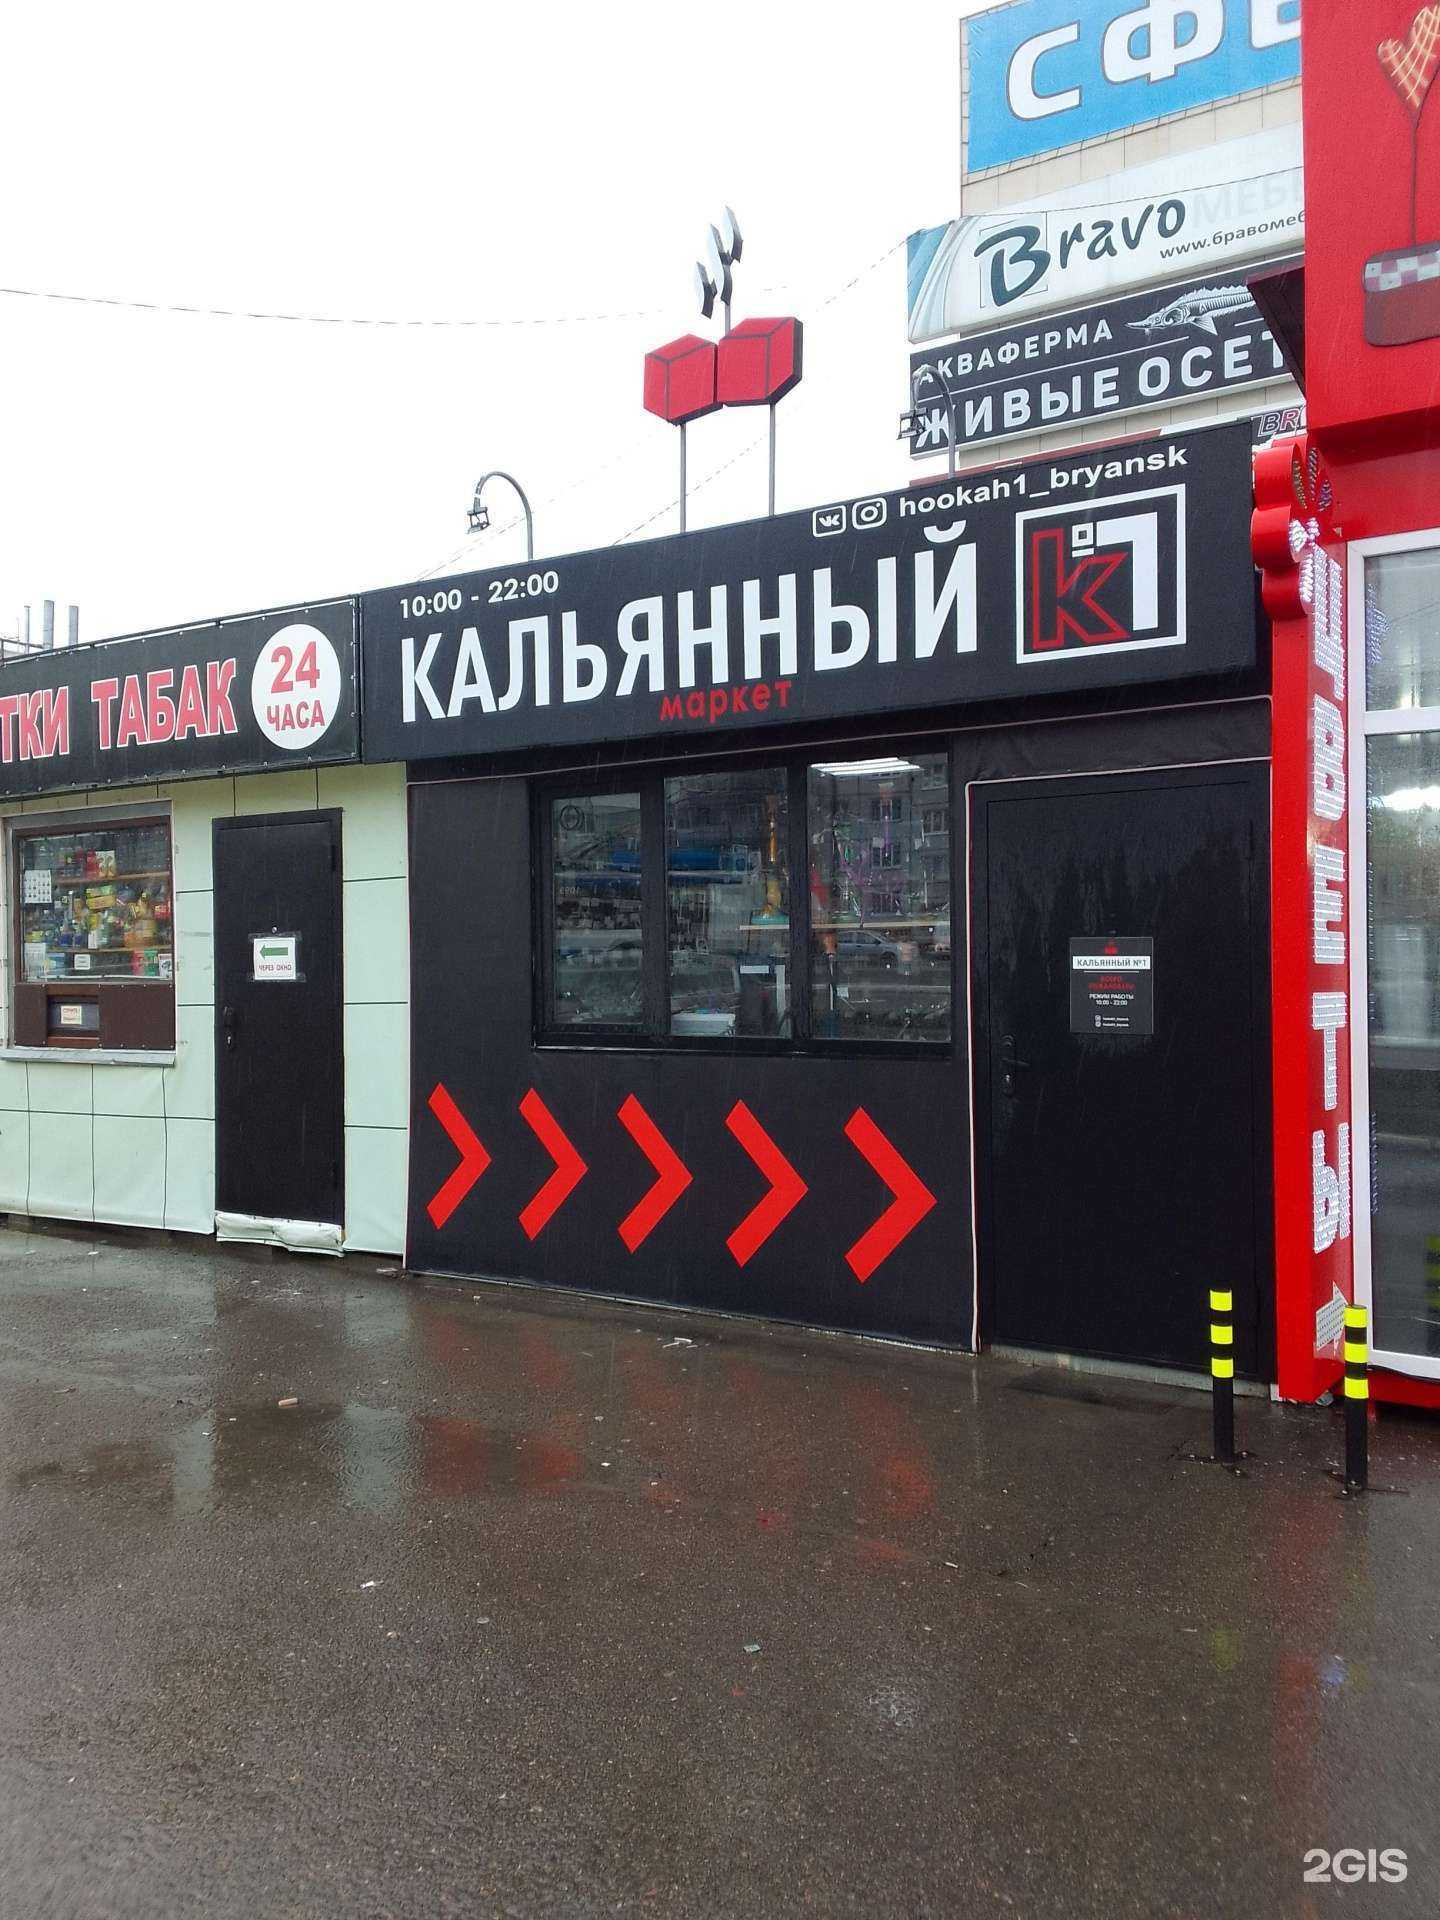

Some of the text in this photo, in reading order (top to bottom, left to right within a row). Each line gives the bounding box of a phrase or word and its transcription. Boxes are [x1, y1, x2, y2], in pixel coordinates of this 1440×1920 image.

[974, 199, 1185, 306] Bravo
[915, 367, 1120, 448] ЖИВЫЕ
[900, 446, 1188, 517] hookah1_bryansk
[400, 589, 462, 619] 10:00
[488, 571, 559, 603] 22:00
[401, 519, 978, 723] КАЛЬЯННЫЙ
[270, 641, 321, 694] 24
[91, 658, 238, 750] ТАБАК
[266, 700, 326, 733] ЧАСА
[659, 680, 793, 723] маркет
[1077, 958, 1131, 968] КАЛЬЯННЫЙ
